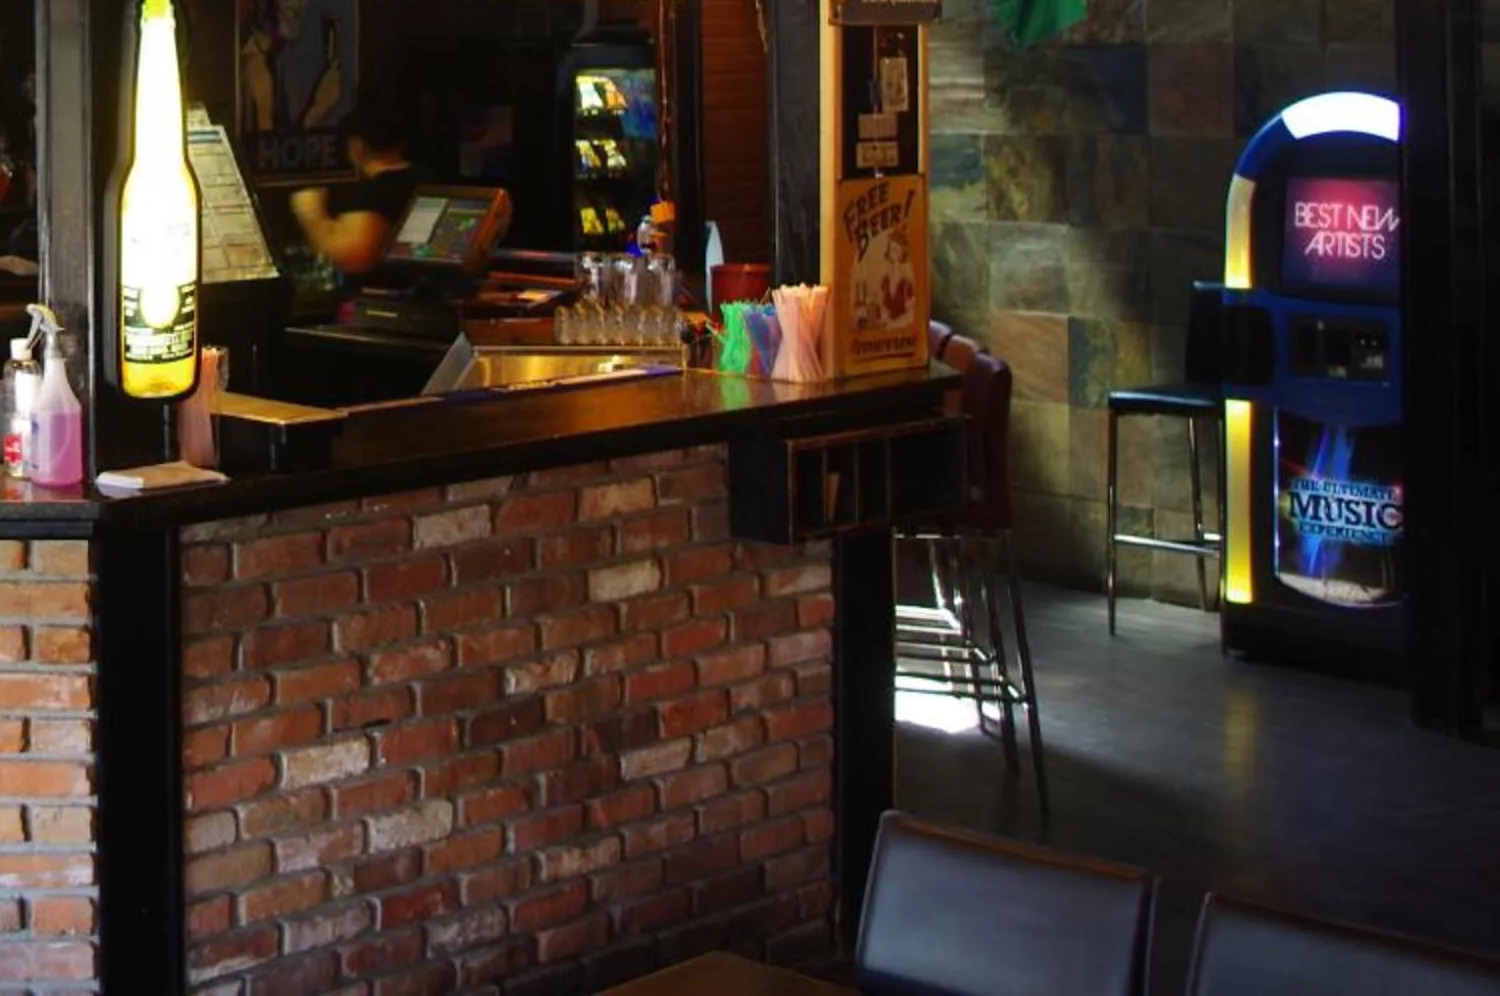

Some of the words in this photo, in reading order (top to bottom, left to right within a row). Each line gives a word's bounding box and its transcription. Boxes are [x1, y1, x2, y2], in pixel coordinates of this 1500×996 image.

[256, 134, 340, 171] HOPE
[843, 181, 890, 244] FREE
[1294, 202, 1342, 228] BEST
[1346, 204, 1400, 232] NEW
[1304, 230, 1386, 261] ARTISTS
[1293, 478, 1320, 492] THE
[1288, 492, 1404, 529] MUSIC
